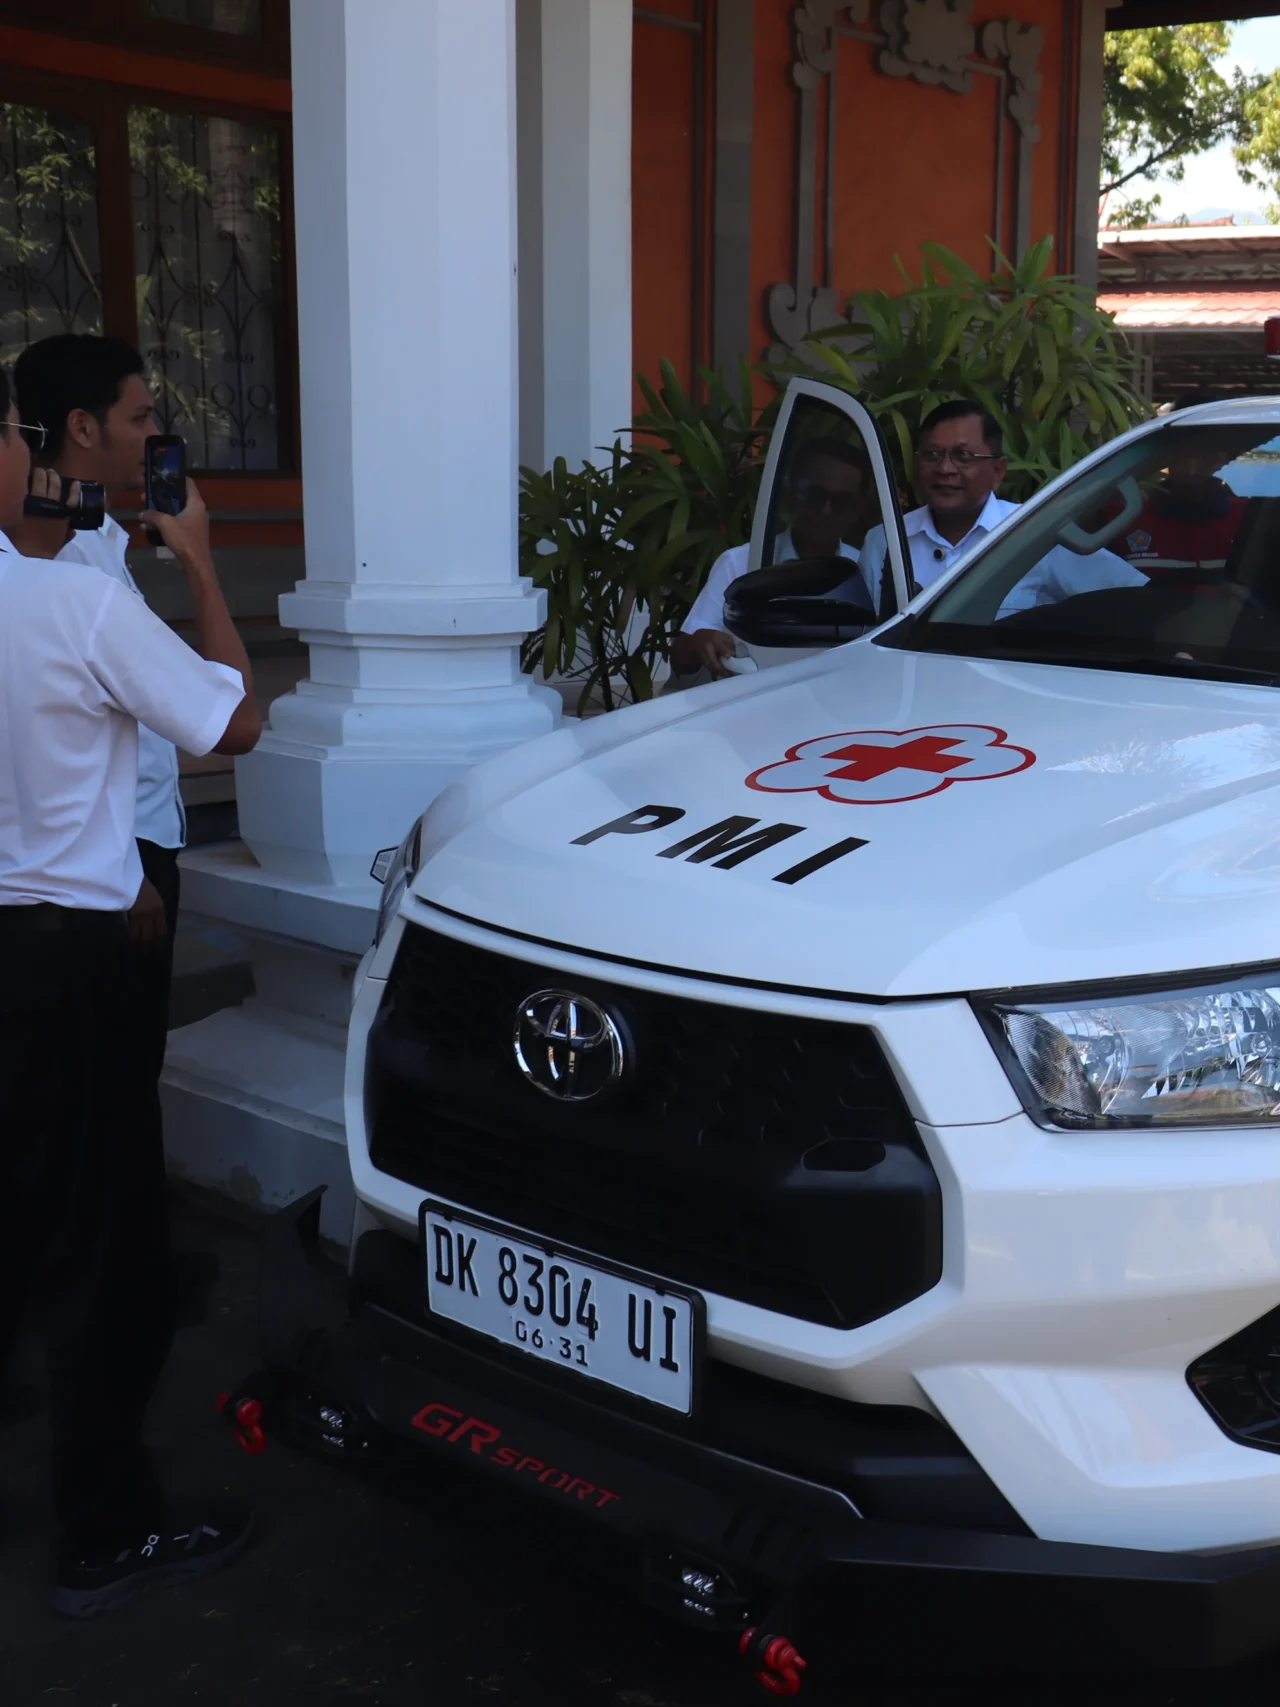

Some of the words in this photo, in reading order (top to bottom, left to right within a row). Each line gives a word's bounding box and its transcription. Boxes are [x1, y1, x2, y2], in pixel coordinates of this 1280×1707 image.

[568, 804, 872, 885] PMI
[432, 1224, 480, 1297] DK
[498, 1246, 599, 1341] 8304
[627, 1292, 679, 1374] UI
[410, 1402, 502, 1454] GR
[489, 1446, 622, 1508] SPORT
